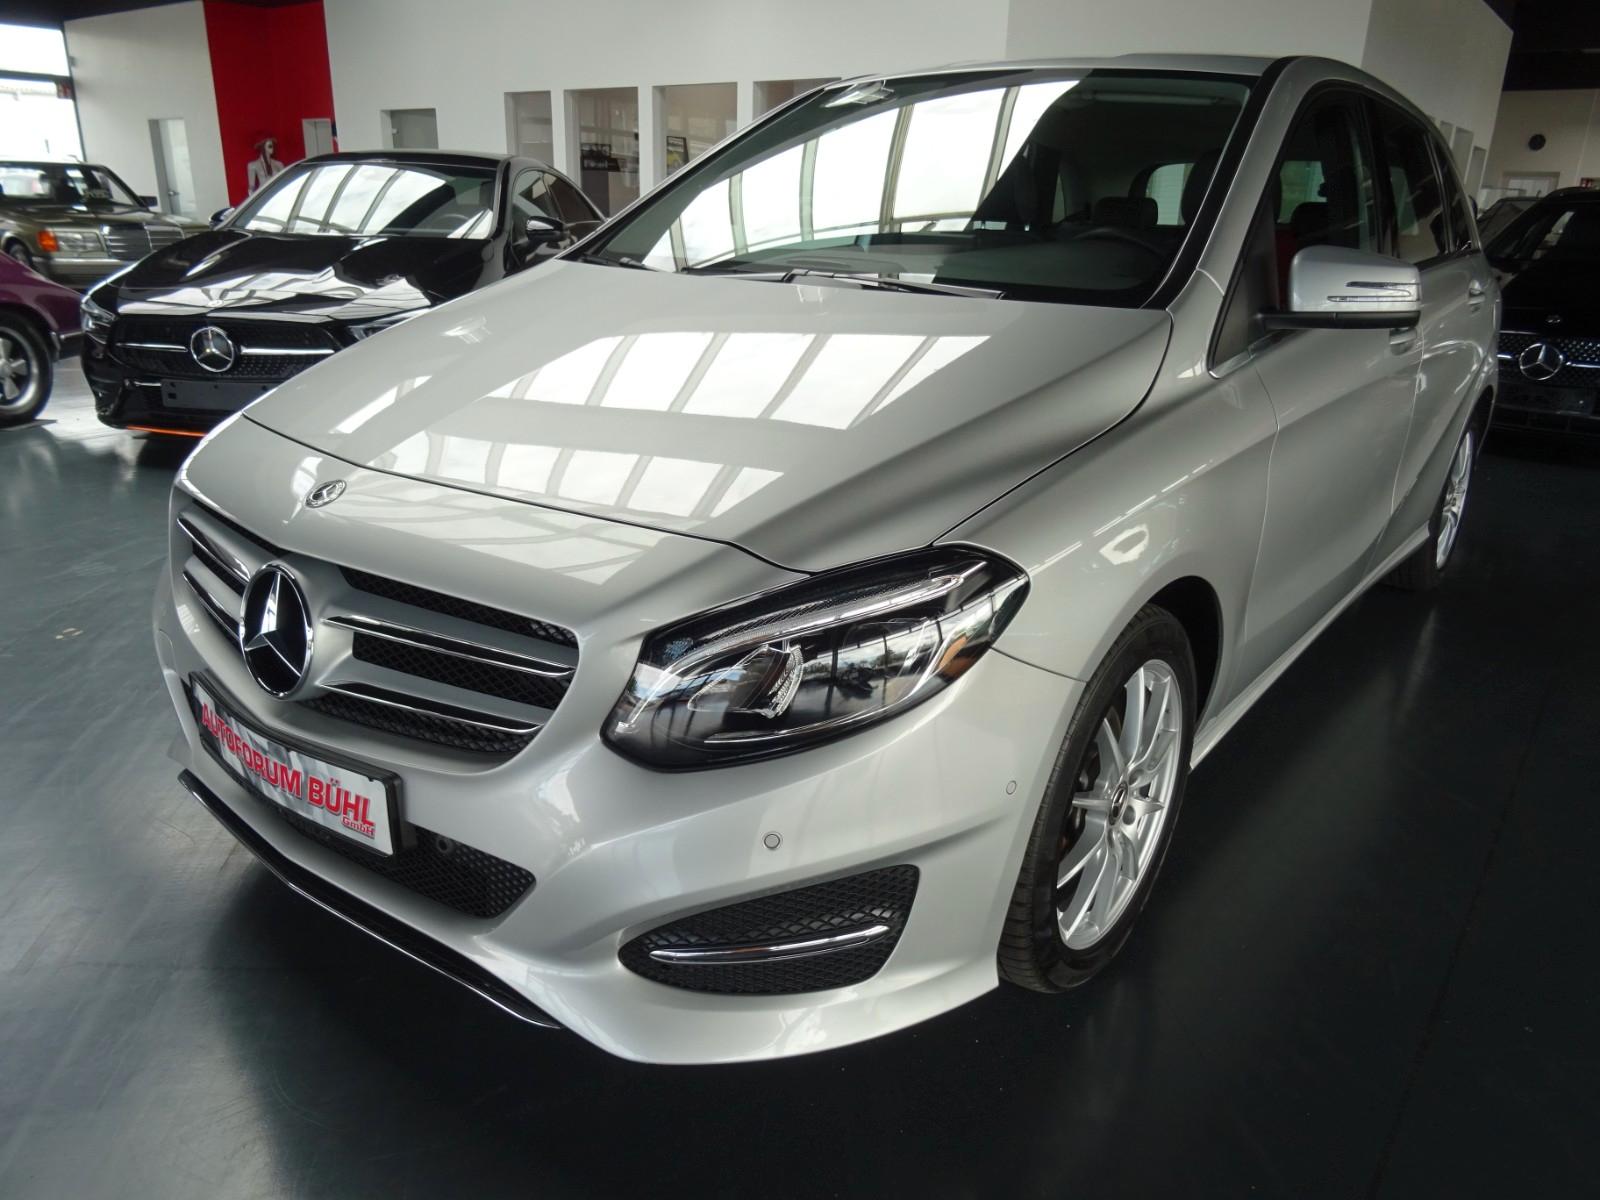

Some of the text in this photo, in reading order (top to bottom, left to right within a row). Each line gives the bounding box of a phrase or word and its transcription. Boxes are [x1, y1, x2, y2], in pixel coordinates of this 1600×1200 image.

[202, 703, 376, 828] AUTOFORUM BÜHL
[341, 815, 376, 839] GmbH
